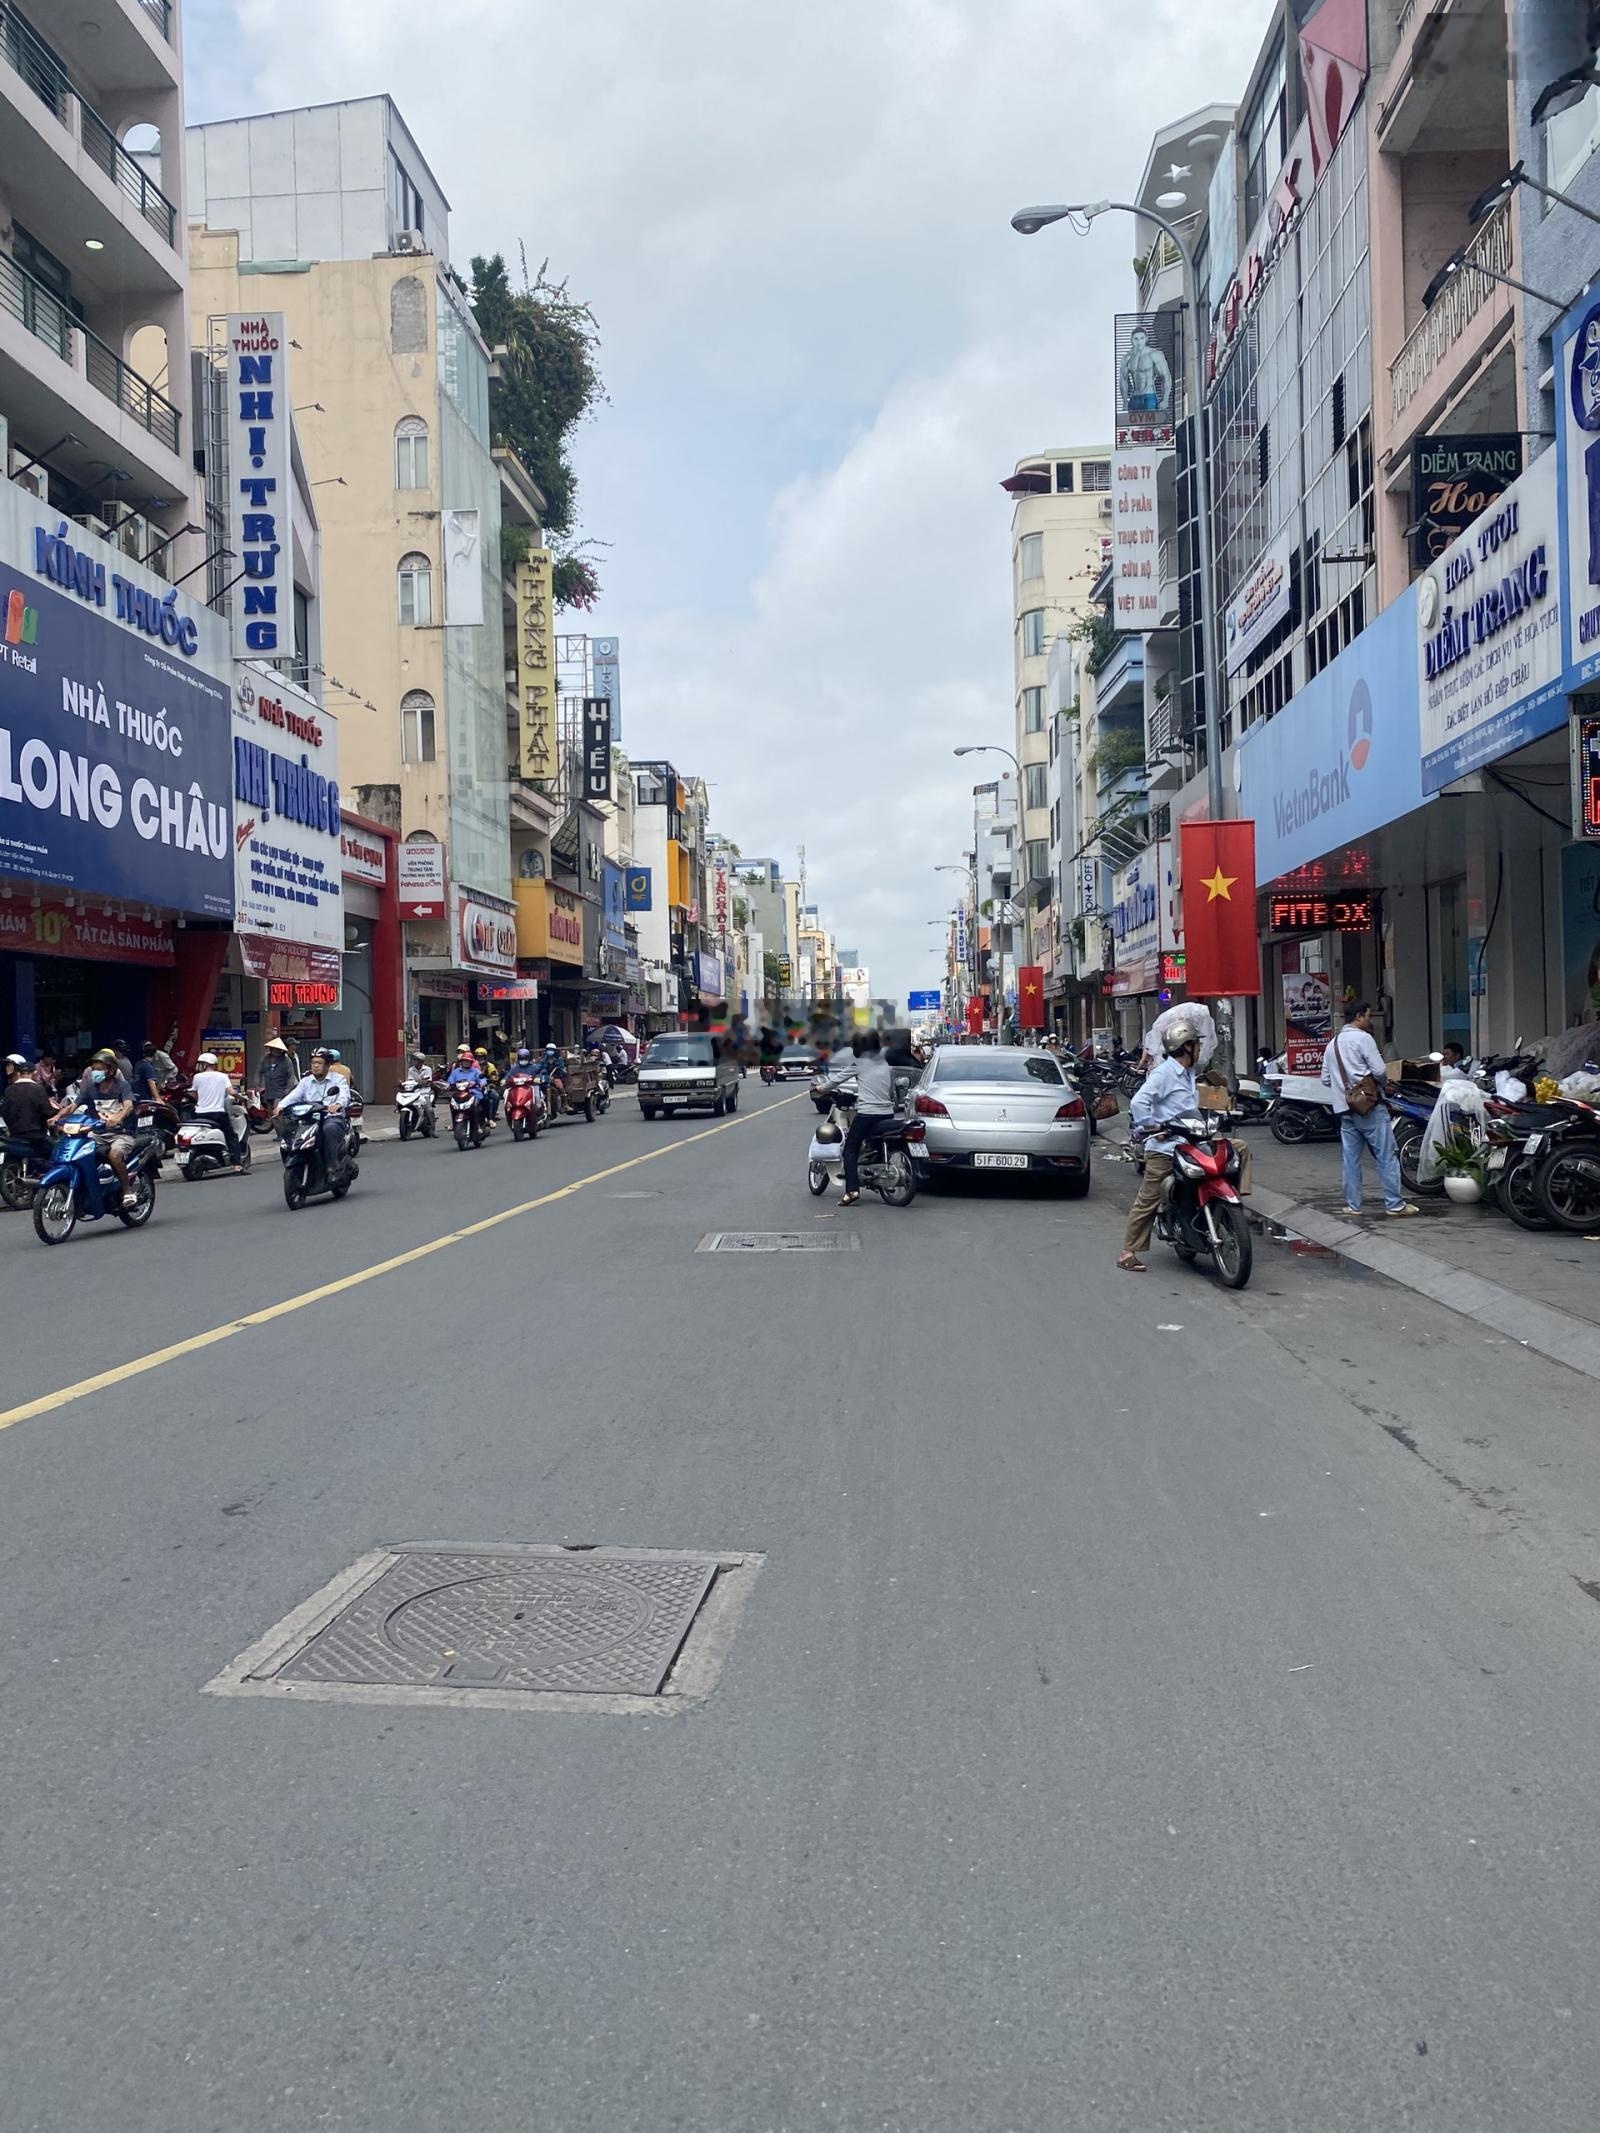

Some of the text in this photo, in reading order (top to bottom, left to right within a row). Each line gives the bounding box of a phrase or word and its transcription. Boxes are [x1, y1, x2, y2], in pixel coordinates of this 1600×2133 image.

[232, 331, 279, 351] THUỐC
[240, 318, 269, 334] NHÀ
[239, 355, 273, 468] NHỊ
[1129, 413, 1156, 423] GYM
[1118, 464, 1152, 480] CÔNG TY
[1462, 450, 1516, 473] TRANG
[1117, 530, 1138, 549] TRỤC
[1445, 502, 1519, 594] HOA TƯƠI
[240, 478, 281, 650] TRƯNG
[35, 521, 198, 656] KÍNH THUỐC
[1118, 594, 1157, 613] VIỆT NAM
[1470, 545, 1549, 645] TRANG
[1524, 622, 1539, 645] HOA
[12, 648, 37, 675] Retail
[62, 676, 183, 758] NHÀ THUỐC
[259, 696, 285, 729] NHÀ
[285, 711, 323, 747] THUỐC
[0, 727, 227, 860] LONG CHÂU
[234, 736, 270, 823] NHỊ
[1273, 750, 1351, 840] VietinBank
[30, 909, 71, 945] 10%
[75, 919, 99, 943] TẤT
[100, 925, 117, 947] CẢ
[118, 930, 141, 950] SẢN
[142, 932, 175, 953] PHẨM
